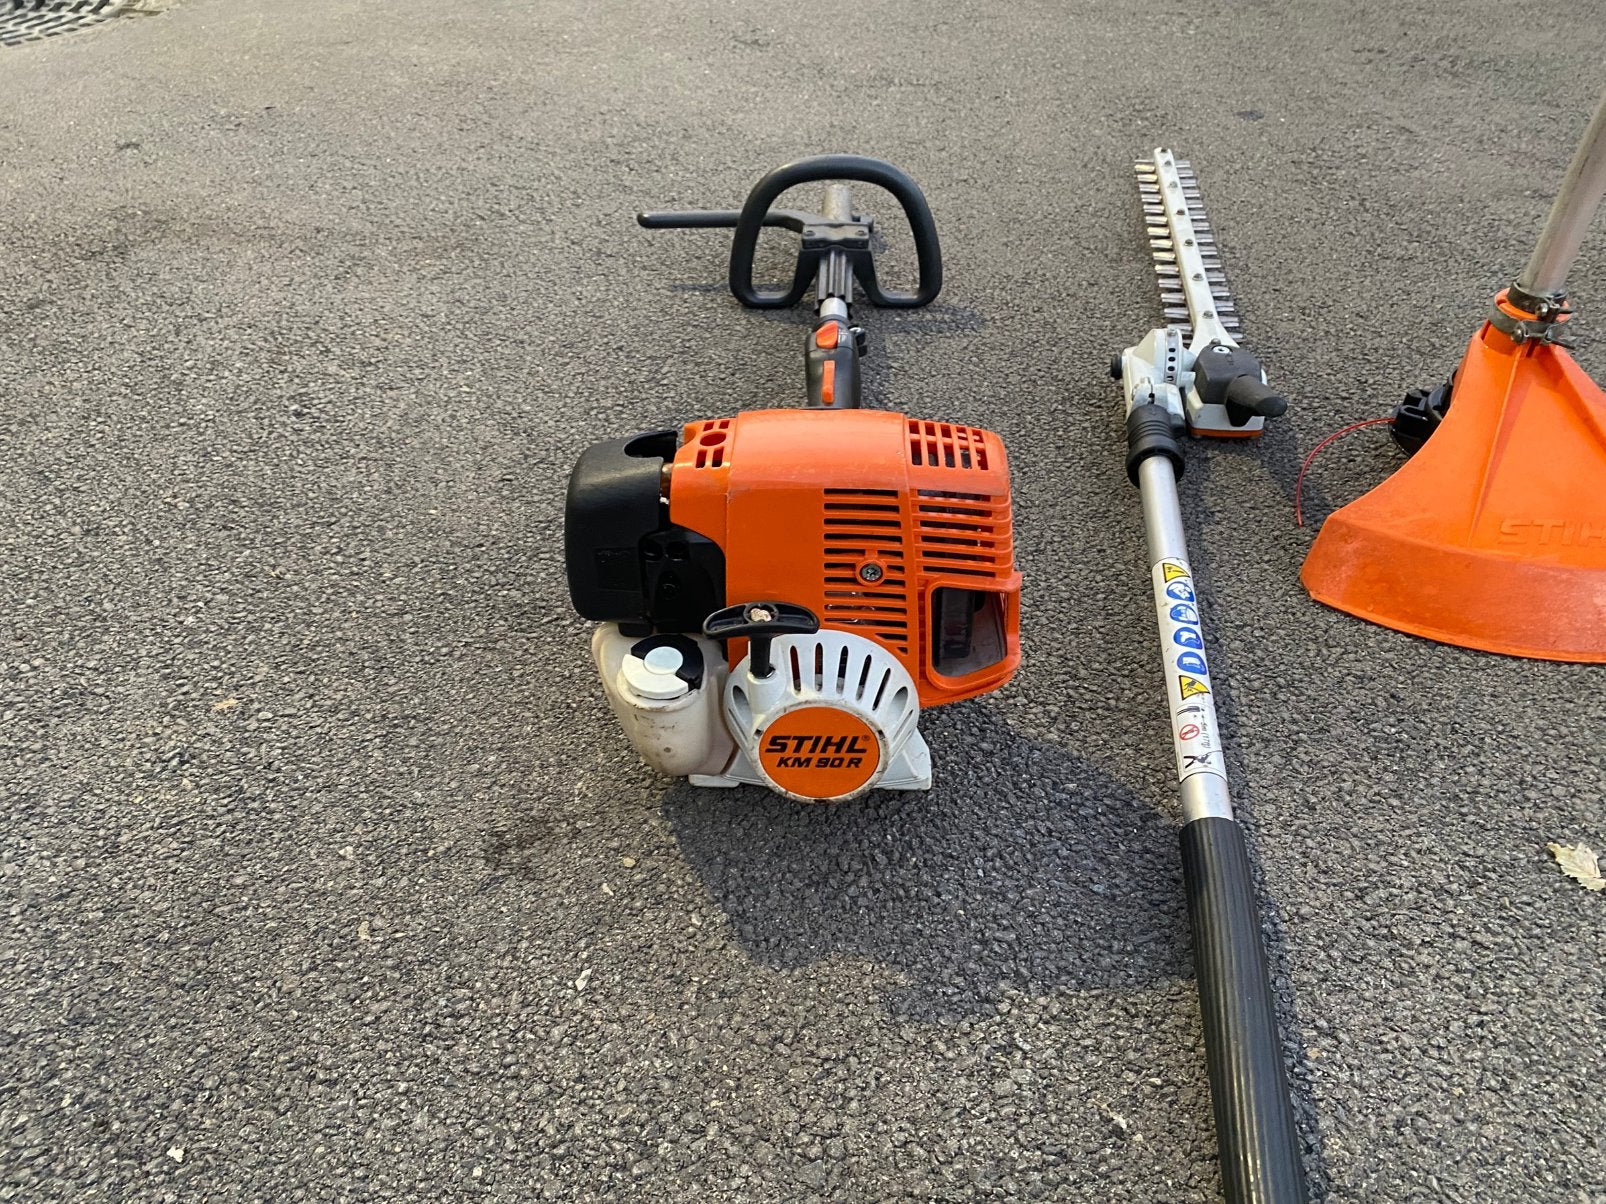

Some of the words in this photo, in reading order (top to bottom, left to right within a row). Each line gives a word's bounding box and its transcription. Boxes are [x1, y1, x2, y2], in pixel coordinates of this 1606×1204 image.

[776, 756, 814, 768] KM
[815, 757, 846, 768] 90
[846, 757, 863, 768] R
